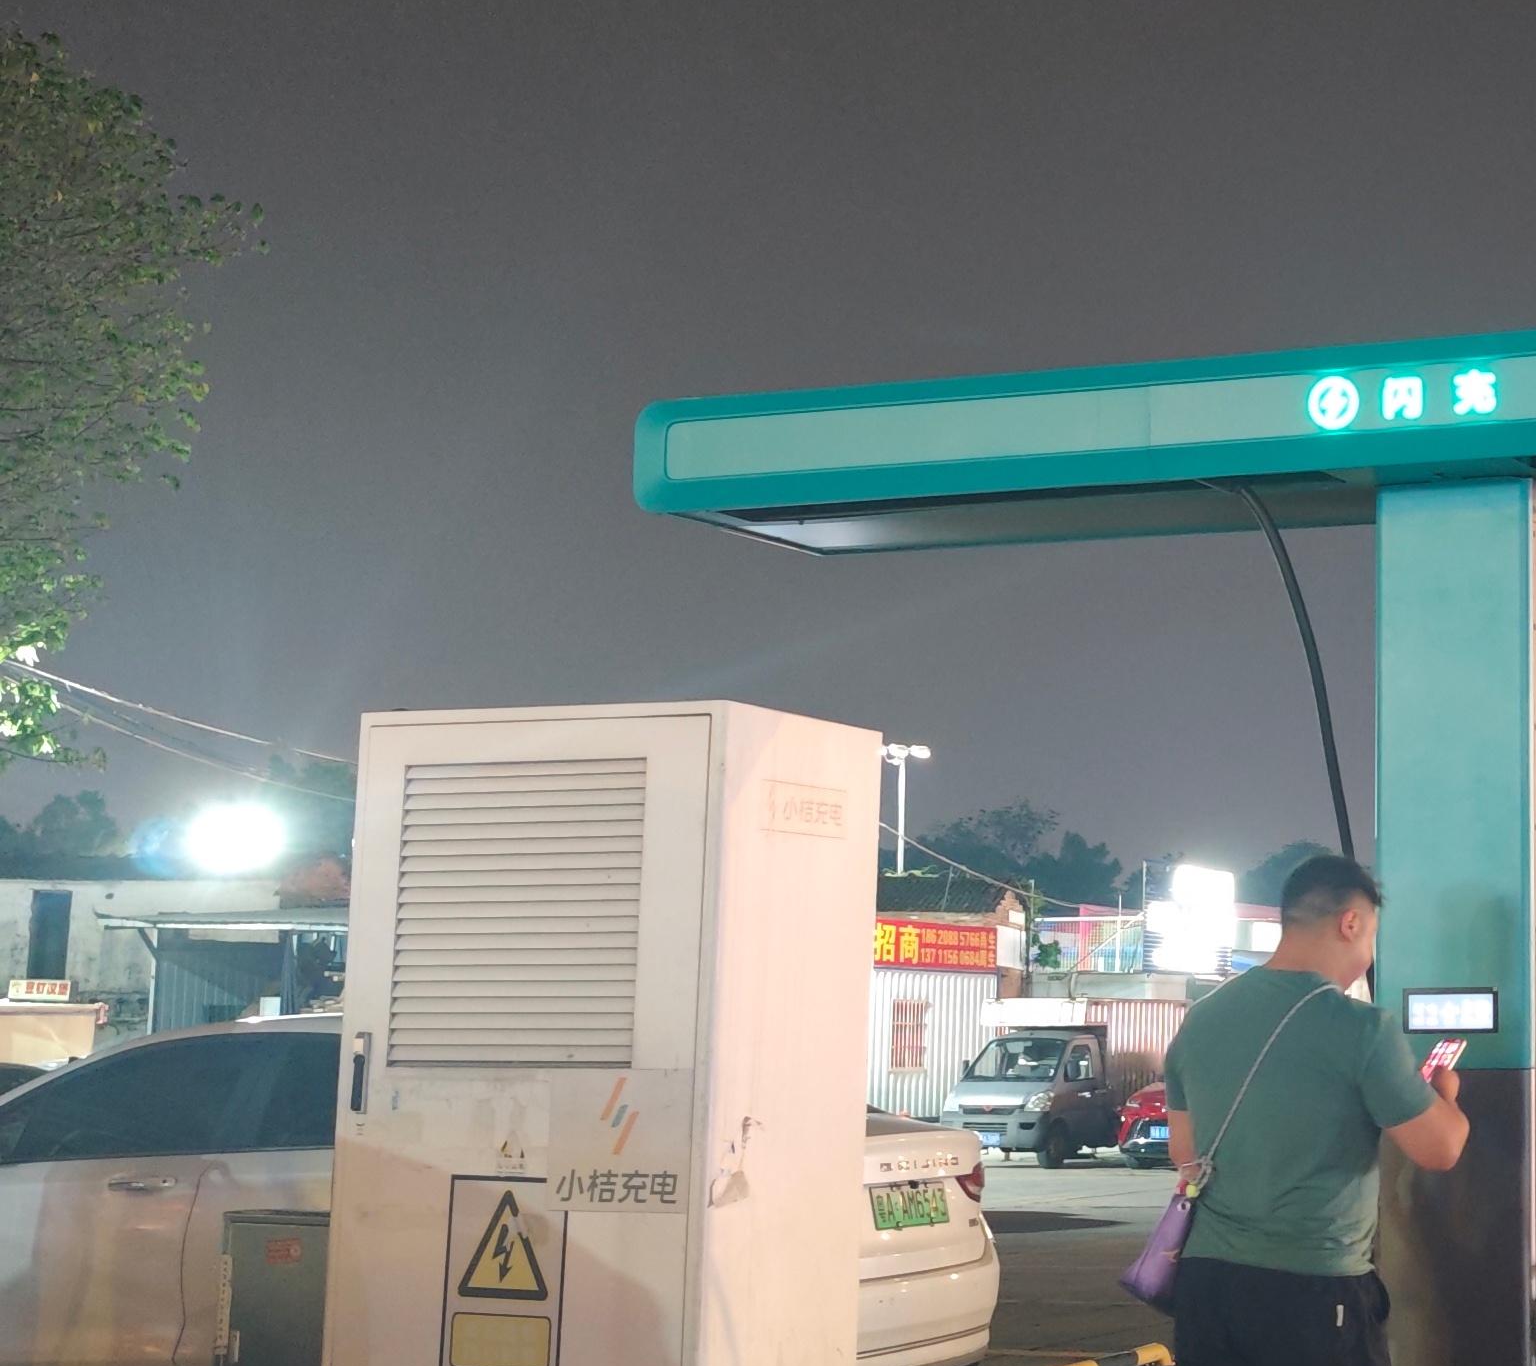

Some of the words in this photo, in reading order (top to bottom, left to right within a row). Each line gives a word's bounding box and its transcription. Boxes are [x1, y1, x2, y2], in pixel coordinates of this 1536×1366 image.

[1381, 368, 1498, 421] 闪充
[782, 796, 843, 827] 小桔充电
[873, 922, 921, 965] 招商
[555, 1168, 679, 1205] 小桔充电
